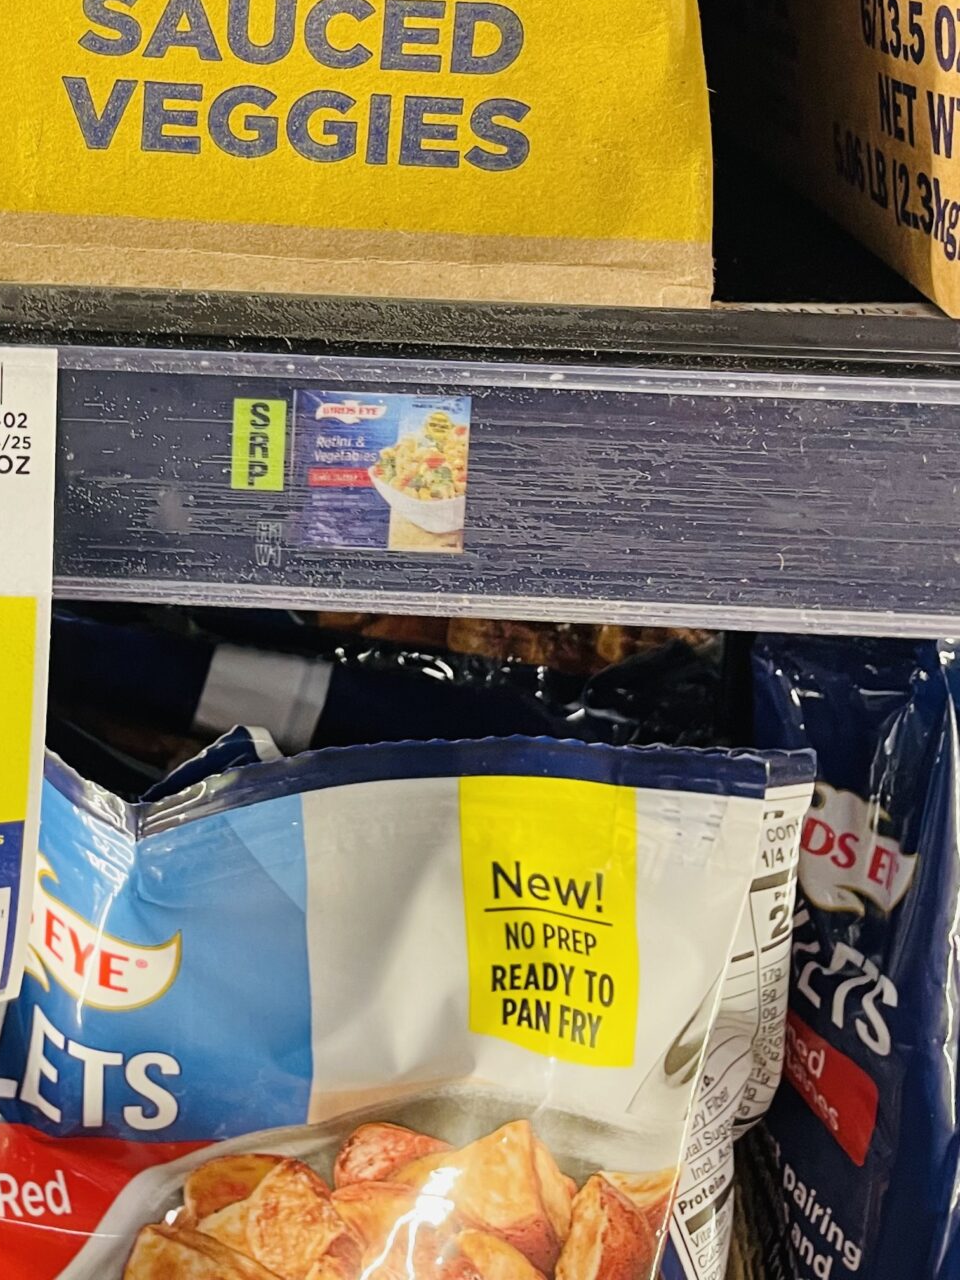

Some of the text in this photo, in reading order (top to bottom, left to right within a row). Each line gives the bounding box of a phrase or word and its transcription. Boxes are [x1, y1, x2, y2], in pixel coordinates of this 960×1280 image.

[935, 4, 960, 72] O
[61, 76, 532, 173] VEGGIES
[878, 72, 916, 148] NET
[867, 142, 888, 209] LB
[893, 159, 960, 262] (2.3kg
[492, 861, 603, 913] New!
[45, 908, 130, 993] EYE
[505, 922, 597, 956] NO PREP
[491, 962, 614, 1008] READY TO
[502, 998, 603, 1049] PAN FRY
[678, 1173, 727, 1215] Protein
[783, 1163, 862, 1271] pairing
